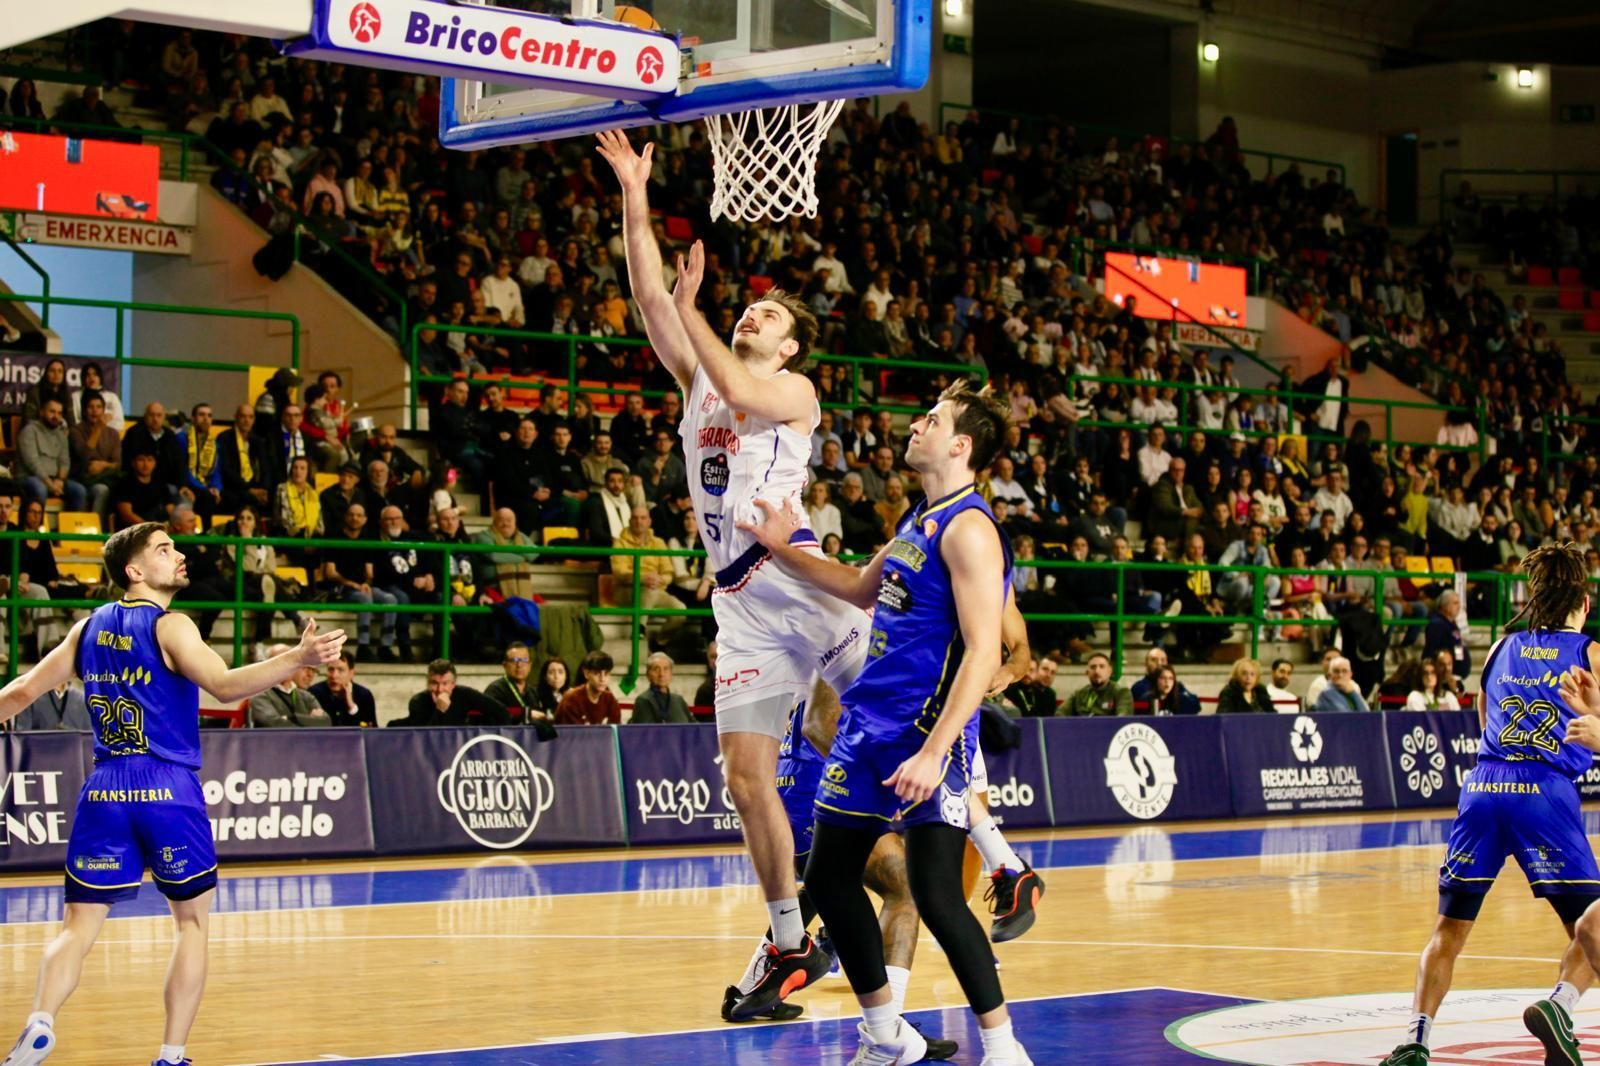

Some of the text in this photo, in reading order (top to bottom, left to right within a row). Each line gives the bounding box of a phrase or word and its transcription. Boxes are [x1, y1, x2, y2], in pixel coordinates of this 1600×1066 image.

[404, 11, 617, 74] BricoCentro
[46, 220, 179, 247] EMERXENCIA
[1498, 694, 1561, 756] 22
[460, 758, 528, 778] ARROCERÍA
[1261, 766, 1362, 788] RECICLAJES VIDAL
[88, 788, 173, 803] TRANSITERIA
[203, 770, 347, 805] oCentro
[457, 775, 532, 812] GIJÓN
[636, 778, 711, 825] pazo
[987, 776, 1035, 808] edo
[1467, 782, 1541, 795] TRANSITERIA
[468, 811, 528, 829] BARBAÑA
